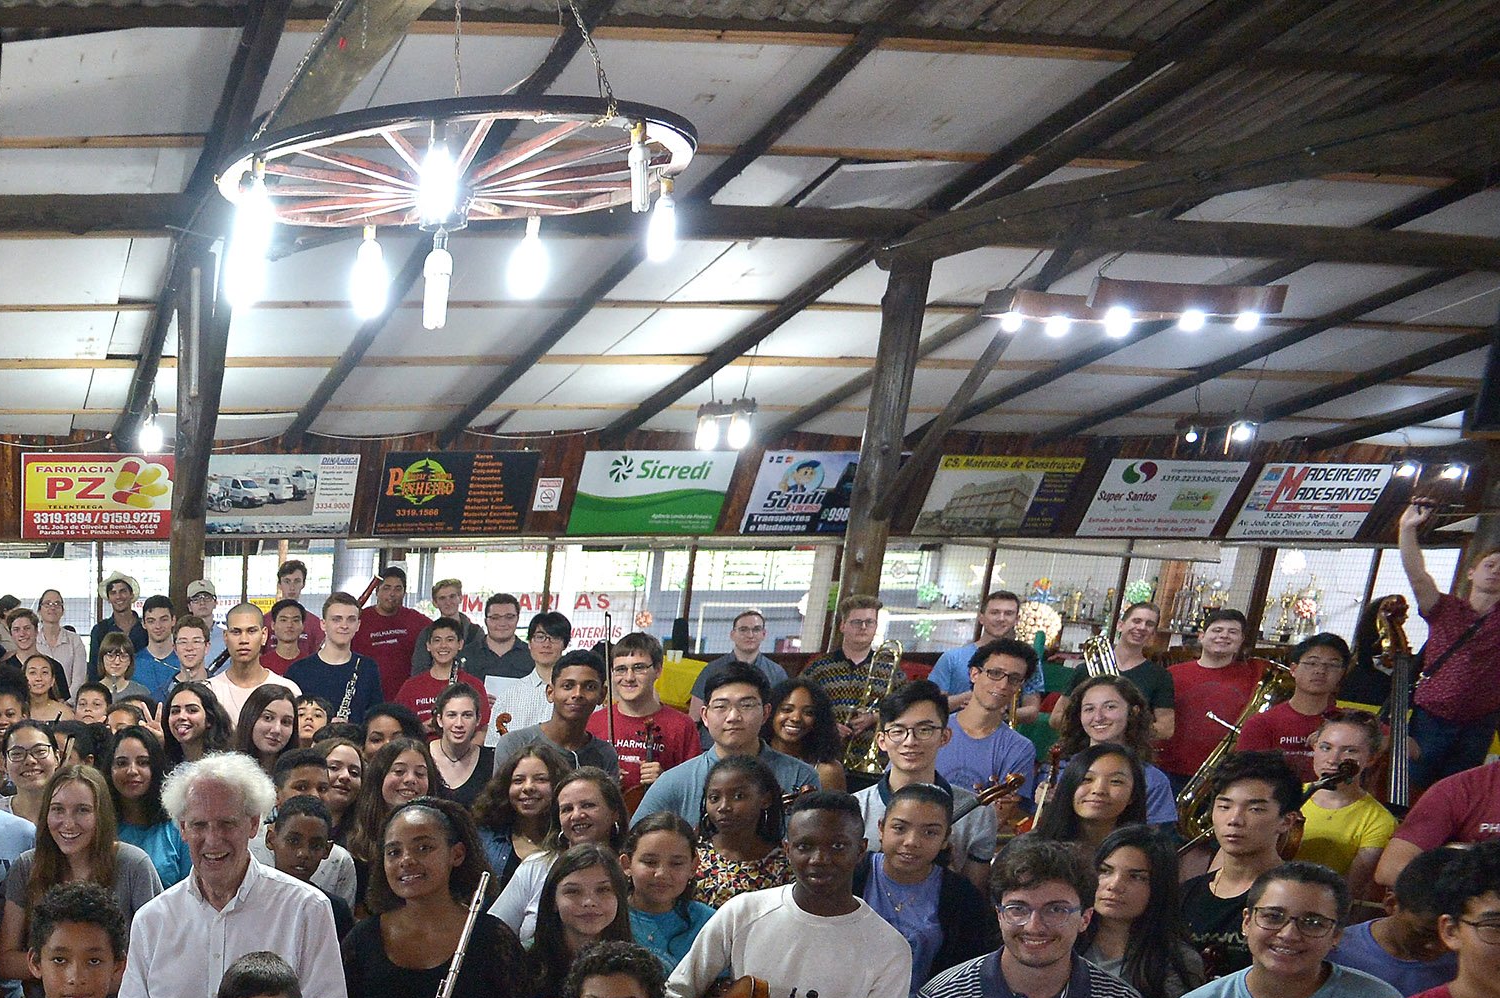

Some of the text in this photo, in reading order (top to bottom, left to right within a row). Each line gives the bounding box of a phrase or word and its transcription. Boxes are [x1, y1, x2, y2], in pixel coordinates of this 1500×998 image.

[36, 464, 114, 473] FARMÁCIA
[636, 459, 713, 480] Sicredi
[964, 458, 1009, 468] Materiais
[1011, 459, 1024, 468] de
[1025, 459, 1081, 470] Construção
[386, 467, 455, 496] PINHEIRO
[46, 477, 106, 499] PZ
[1097, 490, 1157, 502] Super Santos
[33, 512, 92, 524] 3319.1394
[101, 512, 161, 524] 9159.9275
[753, 514, 811, 522] Transportes
[757, 523, 807, 532] Mudanças
